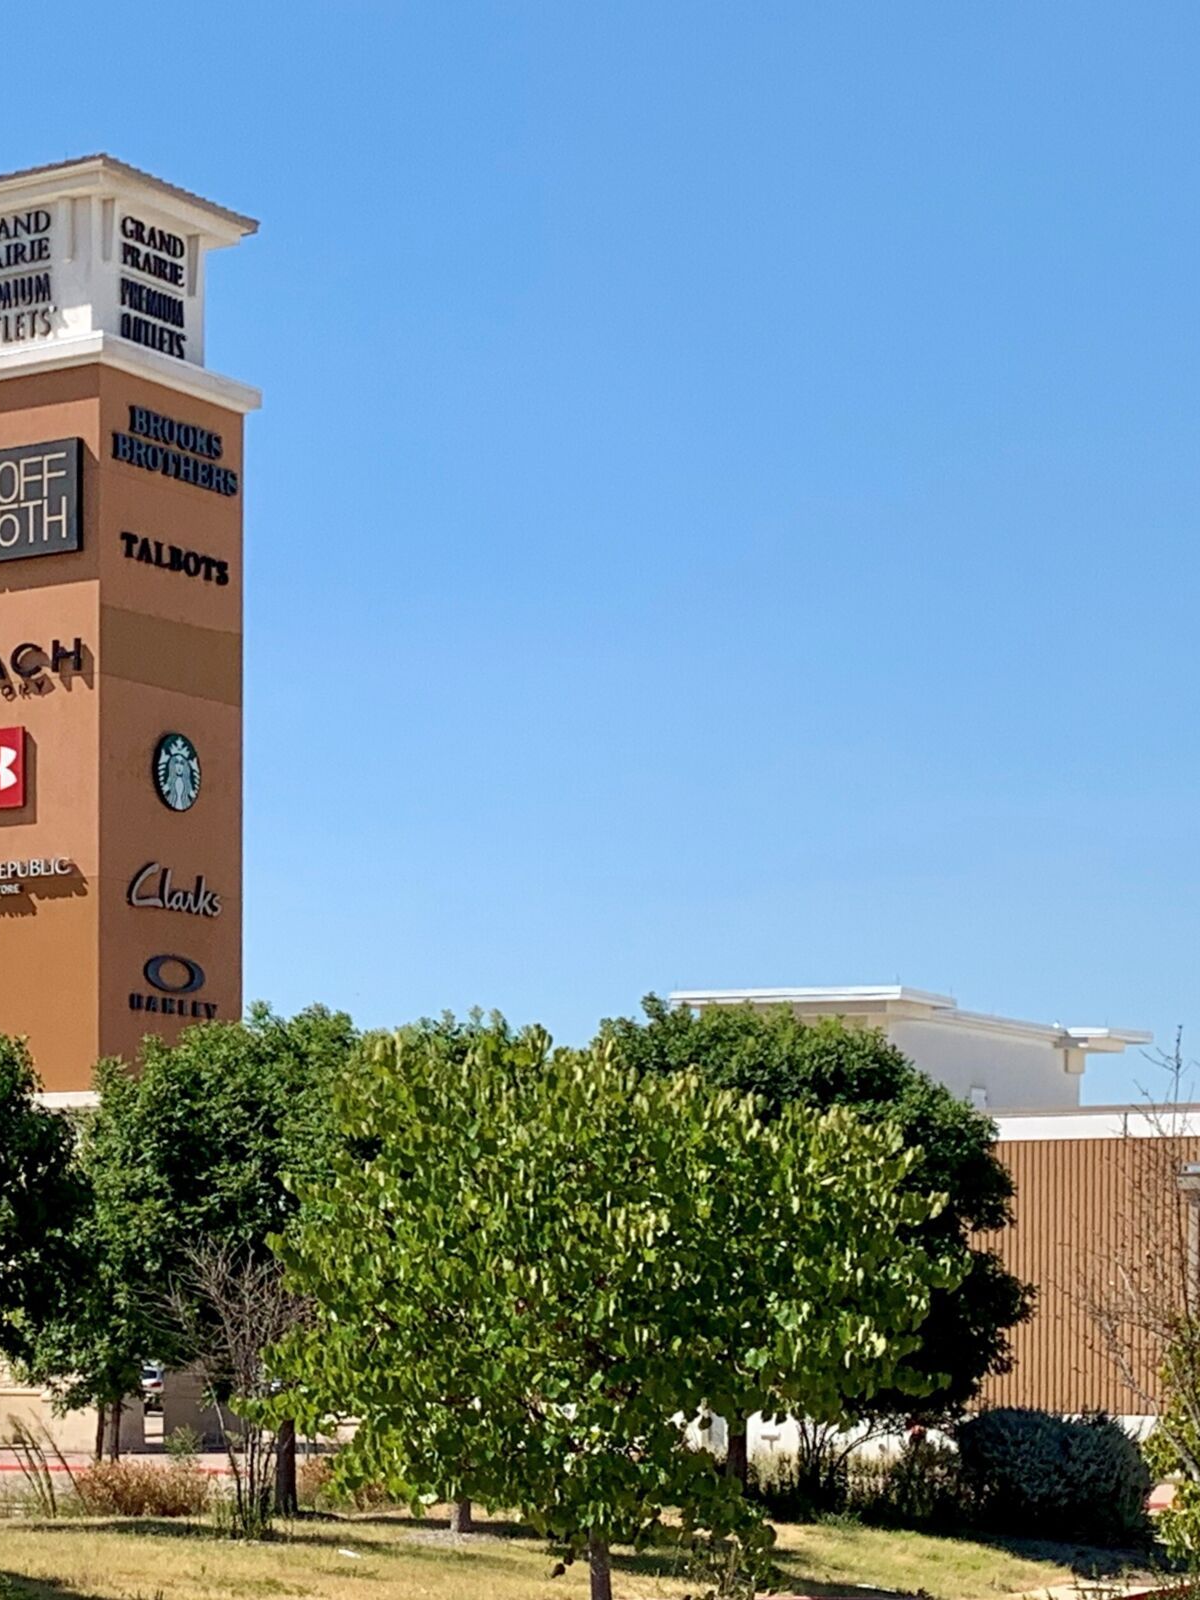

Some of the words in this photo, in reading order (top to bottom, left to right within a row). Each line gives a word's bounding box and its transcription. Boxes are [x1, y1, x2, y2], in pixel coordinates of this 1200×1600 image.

[121, 215, 185, 259] GRAND
[121, 242, 185, 288] PRAIRIE
[120, 278, 184, 328] PREMIUM
[129, 405, 222, 460] BROOKS
[112, 432, 238, 497] BROTHERS
[120, 532, 229, 586] TALBOTS
[127, 861, 222, 916] Clarks
[128, 992, 218, 1020] OAKLEY
